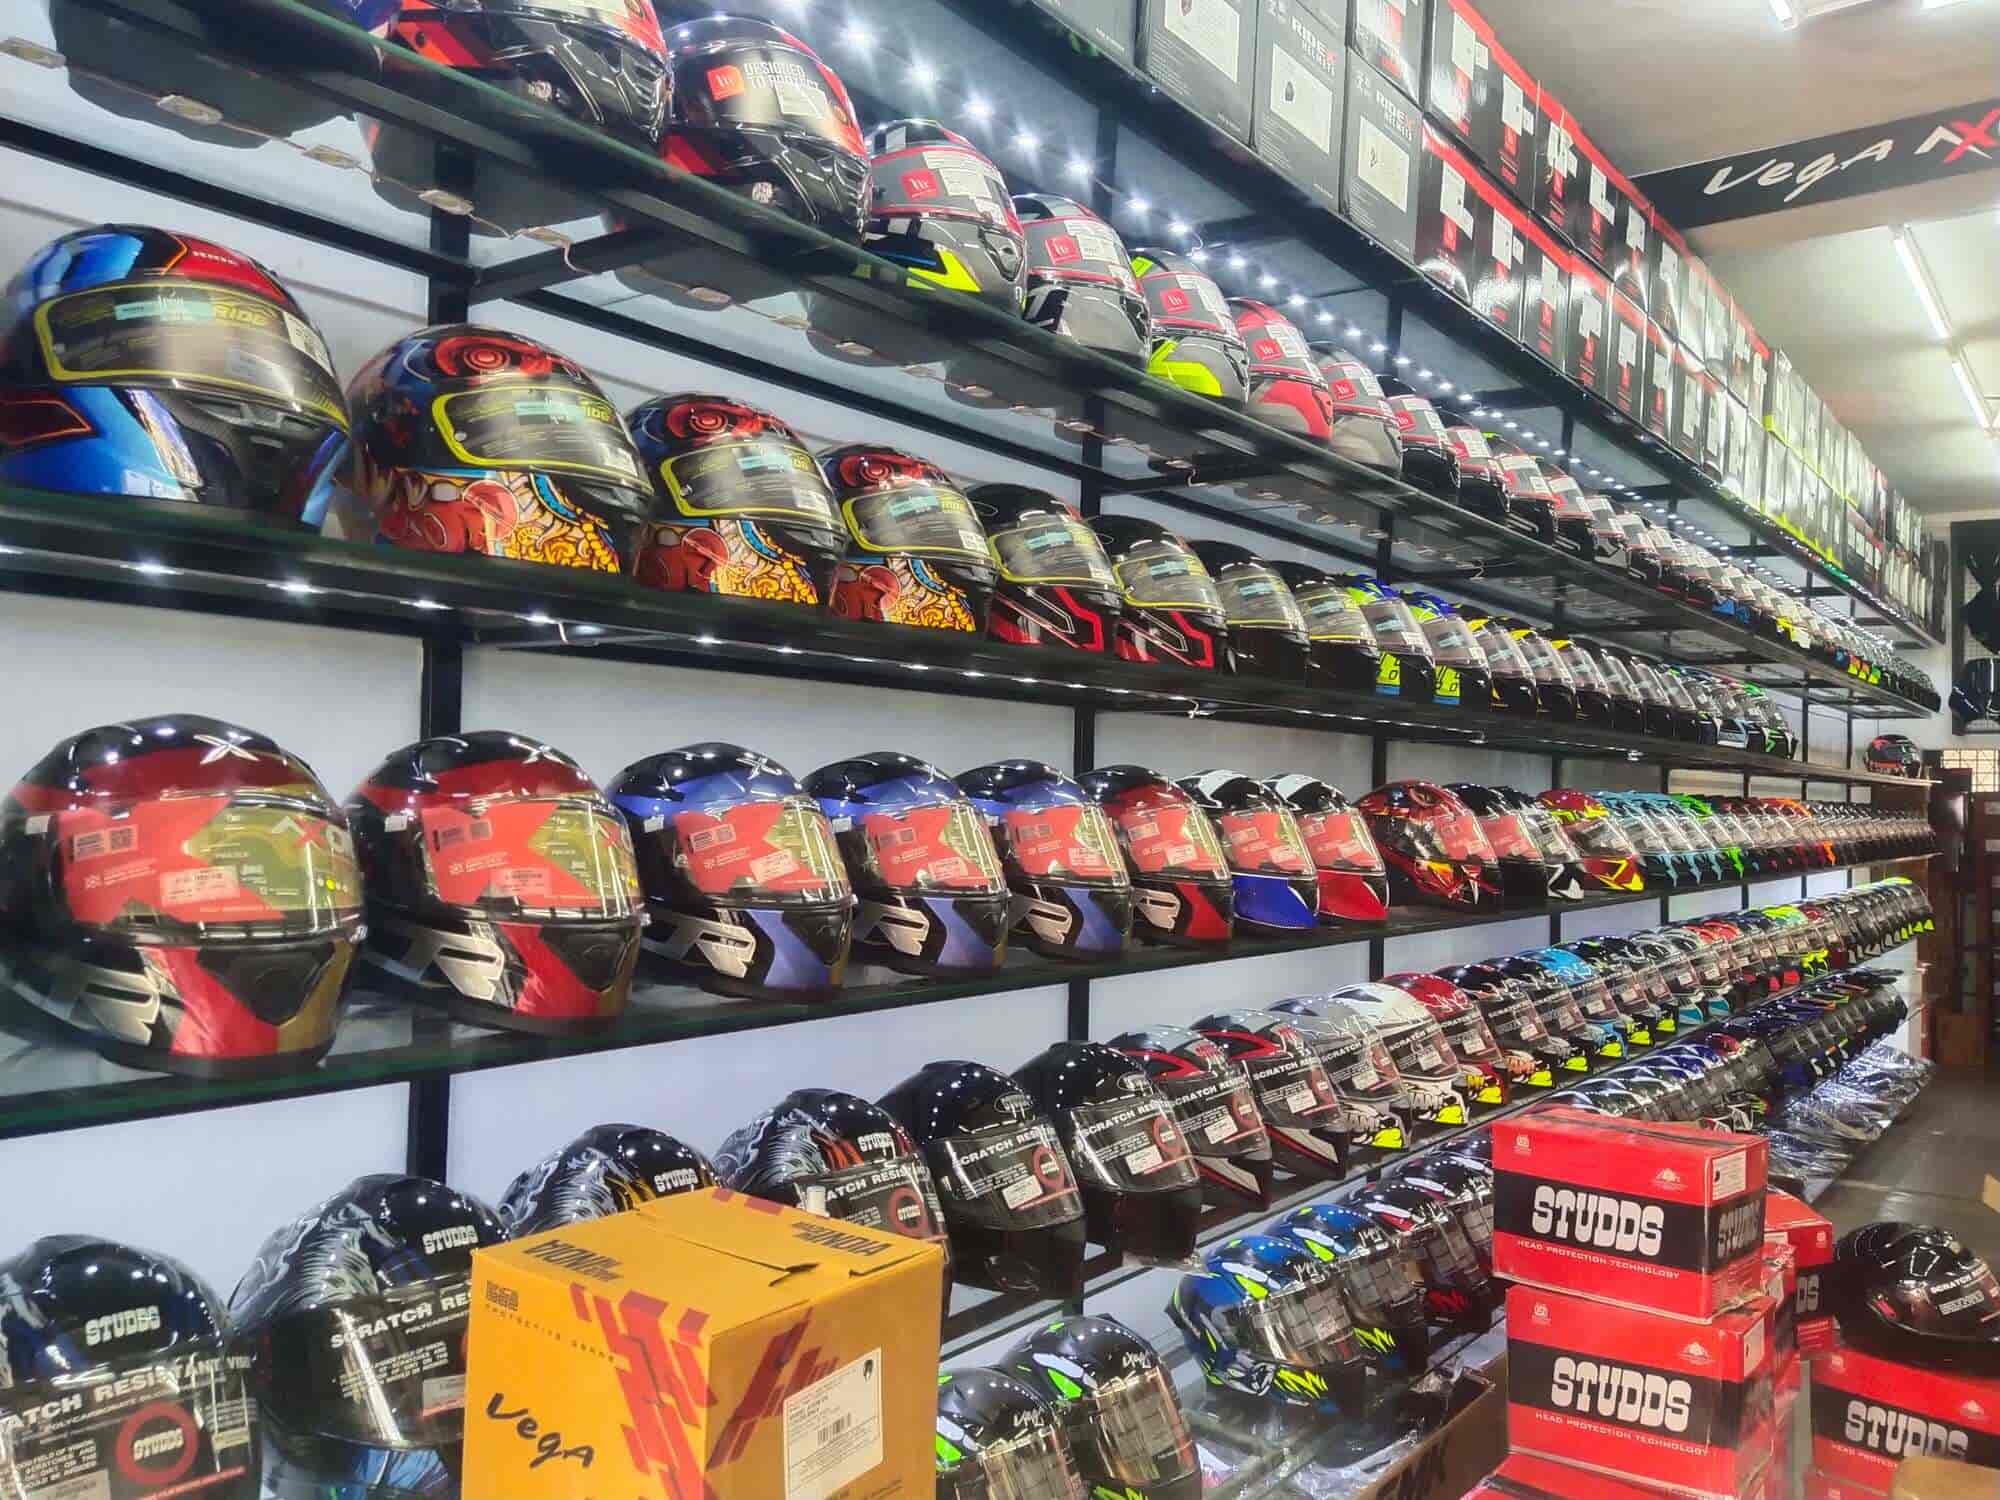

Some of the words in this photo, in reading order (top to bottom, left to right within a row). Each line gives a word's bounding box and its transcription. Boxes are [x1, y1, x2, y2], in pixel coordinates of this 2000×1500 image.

[1914, 108, 2000, 163] AX
[1253, 1062, 1298, 1081] SCRATCH
[1174, 1083, 1217, 1106] CRATCH
[957, 1139, 1013, 1166] CRATCH
[827, 1178, 867, 1201] ATCH
[422, 1225, 478, 1254] STUDDS
[1531, 1185, 1664, 1257] STUDDS
[1517, 1240, 1543, 1251] HEAD
[1546, 1246, 1607, 1264] PROTECTION
[1610, 1259, 1680, 1279] TECHNOLOGY
[85, 1305, 161, 1346] STUDDS
[331, 1302, 433, 1348] SCRATCH
[0, 1394, 82, 1429] ATCH
[1551, 1357, 1692, 1432] STUDDS
[1535, 1411, 1563, 1425] HEAD
[1567, 1418, 1632, 1440] PROTECTION
[1635, 1431, 1709, 1456] TECHNOLOGY
[1845, 1400, 1968, 1457] STUDDS
